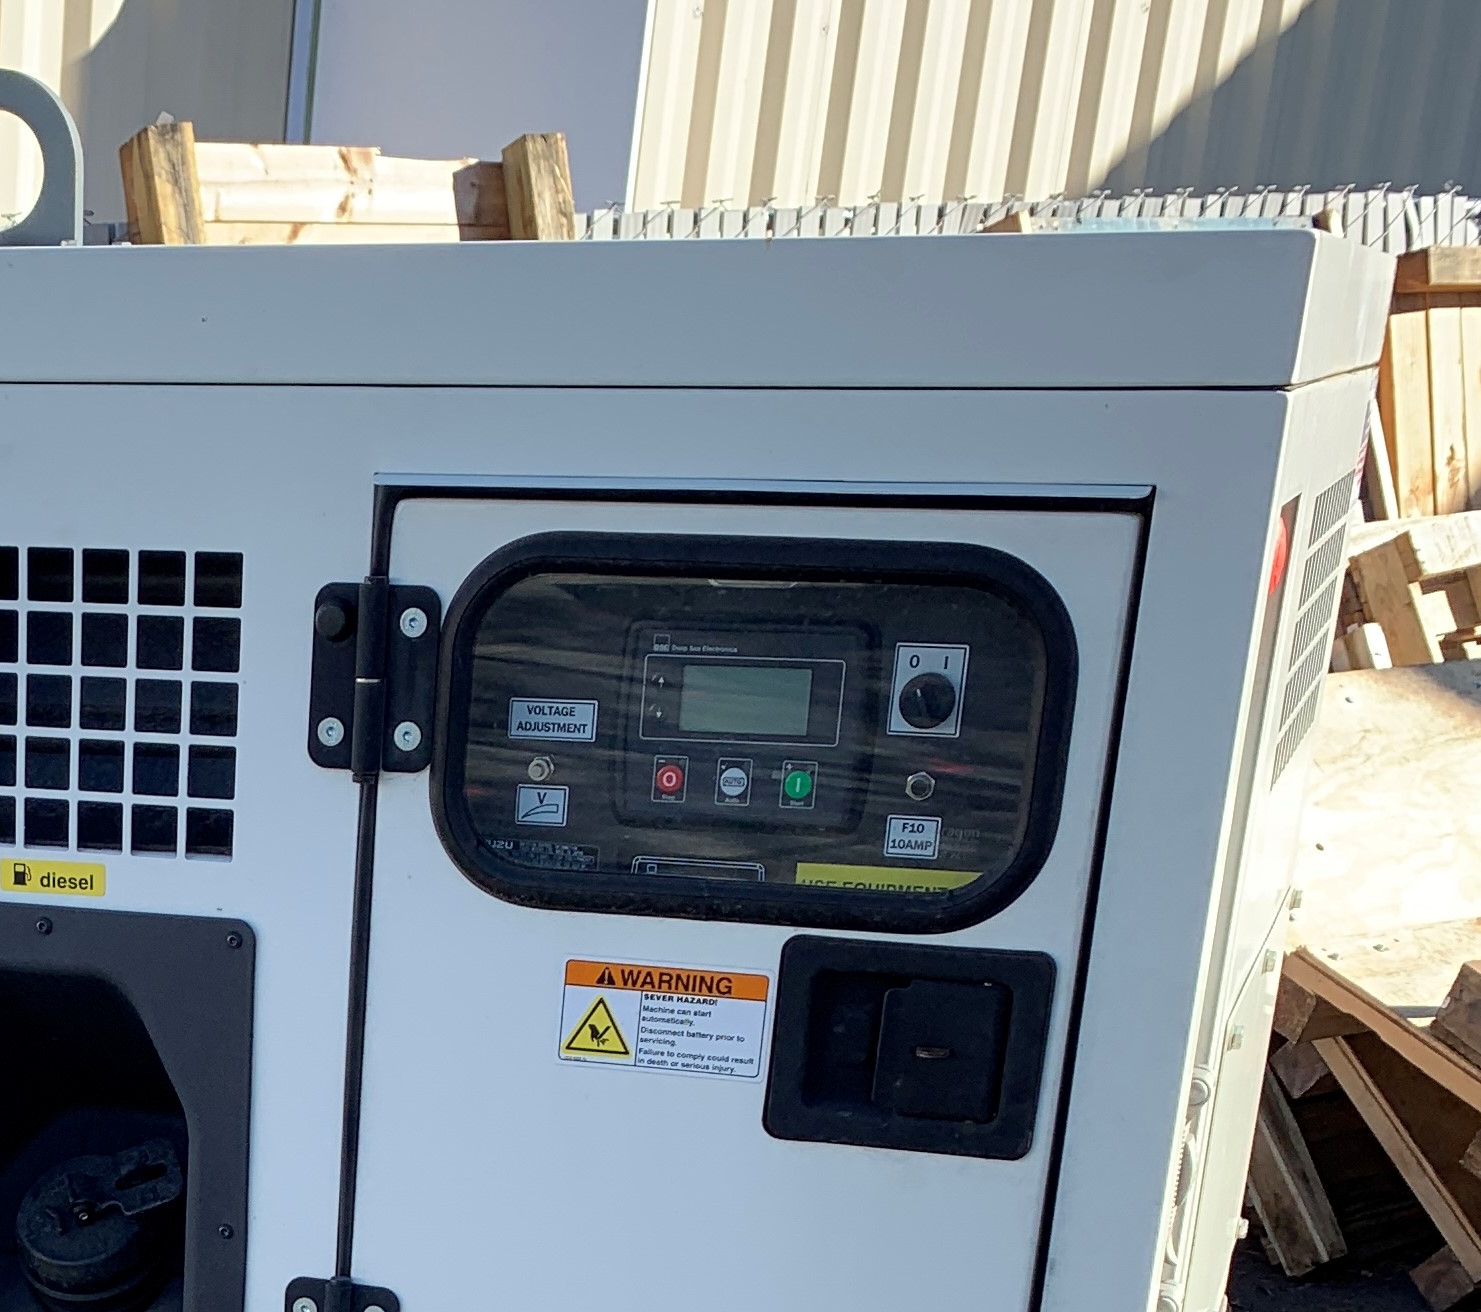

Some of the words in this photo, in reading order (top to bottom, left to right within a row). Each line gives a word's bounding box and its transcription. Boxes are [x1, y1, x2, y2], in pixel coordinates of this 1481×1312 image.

[527, 704, 576, 717] VOLTAGE
[516, 721, 588, 734] ADJUSTMENT
[537, 792, 547, 804] V
[902, 822, 925, 834] F10
[890, 838, 934, 850] 10AMP
[40, 872, 94, 890] diesel
[621, 969, 733, 995] WARNING
[644, 993, 674, 1002] SEVER
[677, 997, 718, 1006] HAZARD!
[643, 1005, 675, 1015] Machine
[693, 1010, 712, 1018] start
[642, 1016, 695, 1027] automatically.
[640, 1026, 684, 1037] Disconnect
[686, 1028, 714, 1041] battery
[715, 1034, 735, 1043] prior
[640, 1037, 677, 1047] servicing.
[638, 1048, 665, 1057] Failure
[677, 1053, 706, 1062] comply
[707, 1054, 729, 1063] could
[731, 1057, 755, 1065] result
[646, 1059, 669, 1067] death
[680, 1062, 710, 1071] serious
[712, 1064, 736, 1074] injury.
